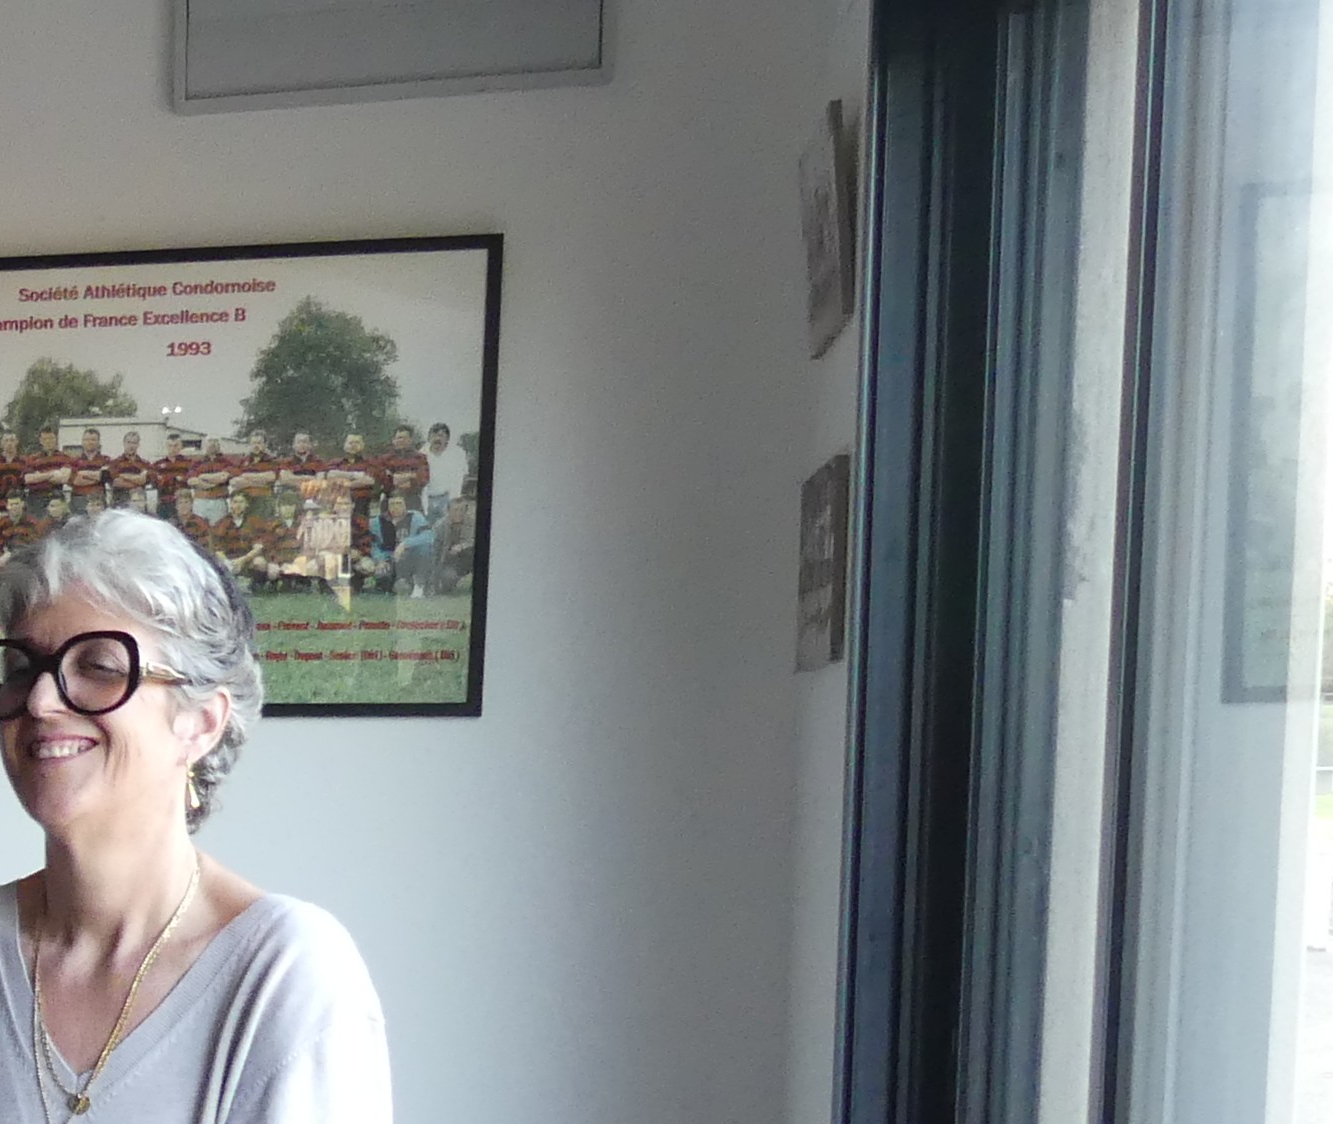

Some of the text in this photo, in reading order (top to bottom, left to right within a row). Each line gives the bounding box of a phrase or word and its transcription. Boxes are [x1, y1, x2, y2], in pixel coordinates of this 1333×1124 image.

[18, 284, 79, 302] Société
[83, 281, 167, 301] Athlétique
[58, 315, 79, 329] de
[83, 312, 138, 328] France
[143, 308, 229, 326] Excellence
[234, 307, 247, 322] B
[166, 341, 212, 357] 1993
